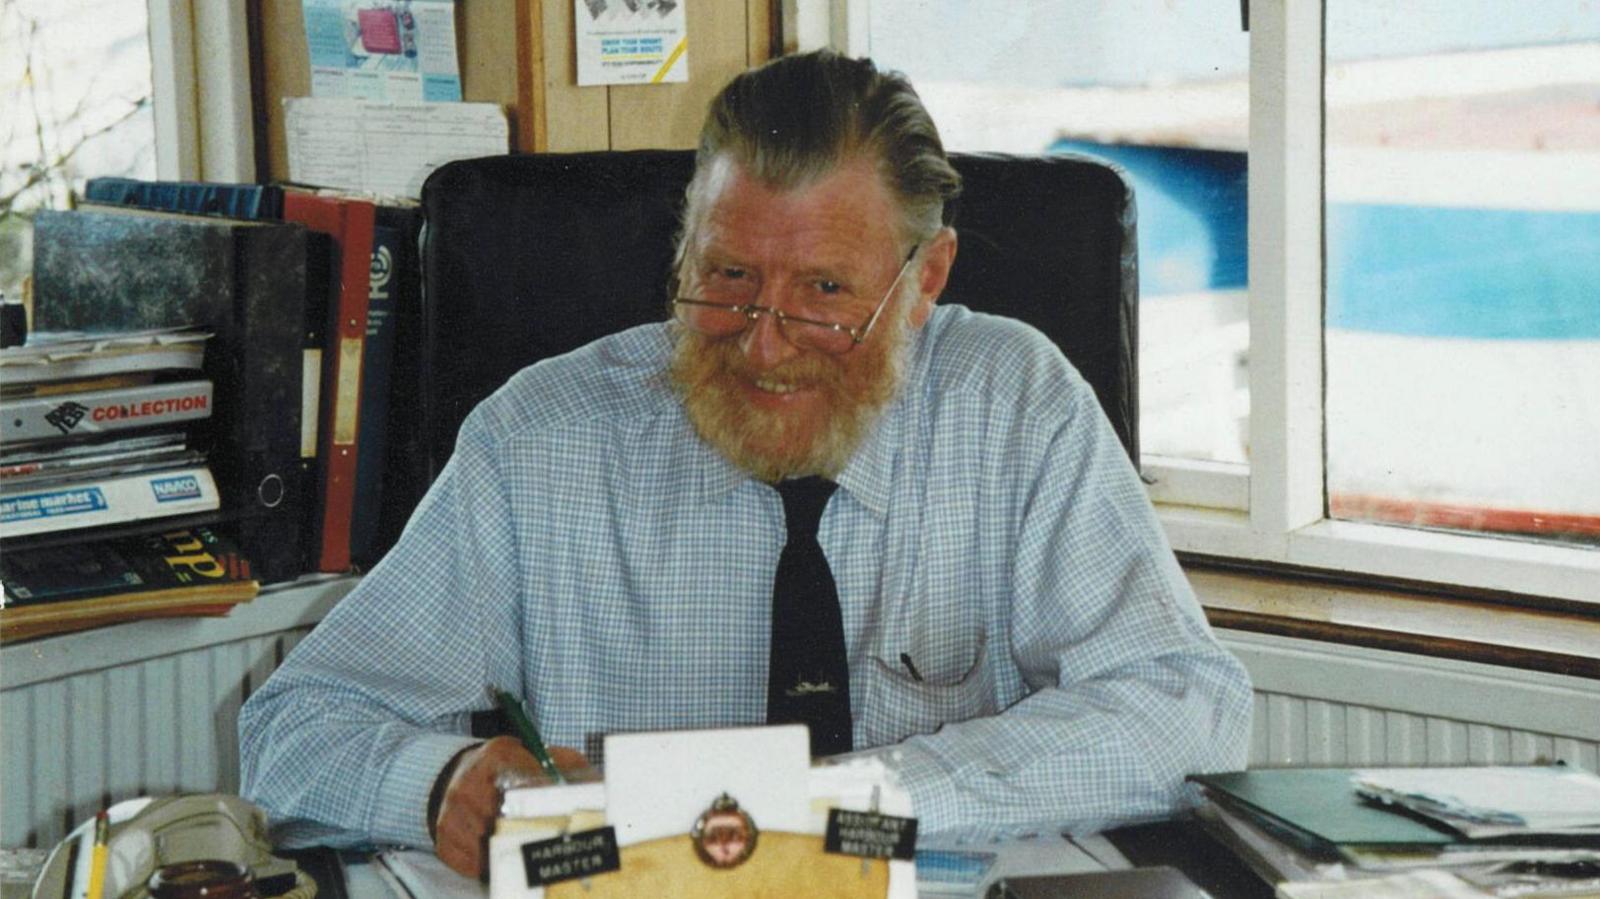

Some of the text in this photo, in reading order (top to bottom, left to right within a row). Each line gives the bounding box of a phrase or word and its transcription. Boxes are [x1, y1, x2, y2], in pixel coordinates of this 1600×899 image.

[92, 395, 207, 422] COLLECTION
[40, 491, 91, 508] market
[839, 827, 900, 845] HARBOUR
[840, 839, 895, 857] MASTER
[539, 854, 603, 879] MASTER
